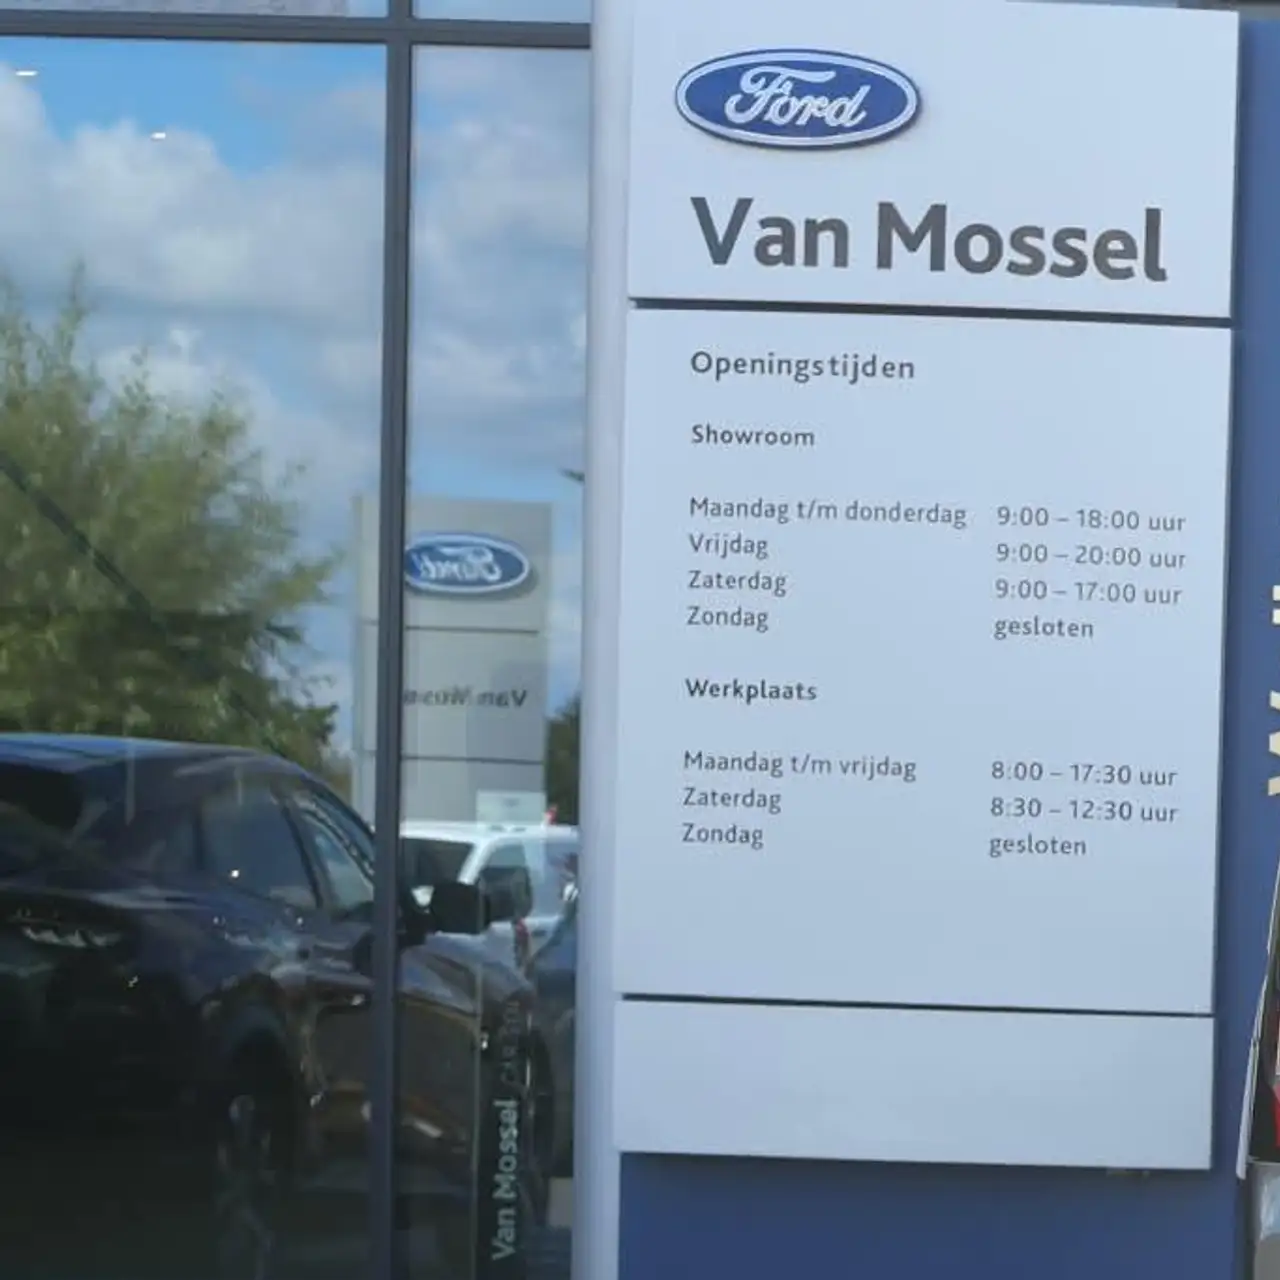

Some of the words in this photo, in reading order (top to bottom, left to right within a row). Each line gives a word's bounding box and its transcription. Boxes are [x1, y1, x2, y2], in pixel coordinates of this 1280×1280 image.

[725, 64, 867, 129] Ford
[691, 196, 850, 269] Van
[876, 201, 1168, 282] Mossel
[690, 350, 916, 384] Openingstijden
[690, 424, 816, 448] Showroom
[688, 497, 790, 525] Maandag
[796, 499, 838, 520] t/m
[844, 502, 969, 530] donderdag
[996, 506, 1050, 527] 9:00
[1075, 508, 1141, 530] 18:00
[1148, 516, 1187, 532] uur
[688, 532, 769, 560] Vrijdag
[996, 543, 1049, 563] 9:00
[1073, 545, 1142, 567] 20:00
[1148, 552, 1187, 569] uur
[687, 569, 788, 598] Zaterdag
[994, 578, 1048, 600] 9:00
[1073, 582, 1137, 604] 17:00
[1144, 588, 1184, 605] uur
[686, 605, 770, 634] Zondag
[993, 615, 1095, 641] gesloten
[684, 677, 818, 706] Werkplaats
[682, 749, 784, 778] Maandag
[790, 753, 833, 775] t/m
[838, 756, 917, 784] vrijdag
[990, 760, 1044, 782] 8:00
[1069, 763, 1133, 785] 17:30
[1138, 769, 1179, 787] uur
[681, 786, 782, 815] Zaterdag
[989, 796, 1043, 818] 8:30
[1068, 800, 1134, 822] 12:30
[1140, 806, 1181, 823] uur
[680, 822, 764, 851] Zondag
[988, 832, 1087, 859] gesloten
[493, 1098, 519, 1200] Mossel
[491, 1207, 517, 1261] Van
